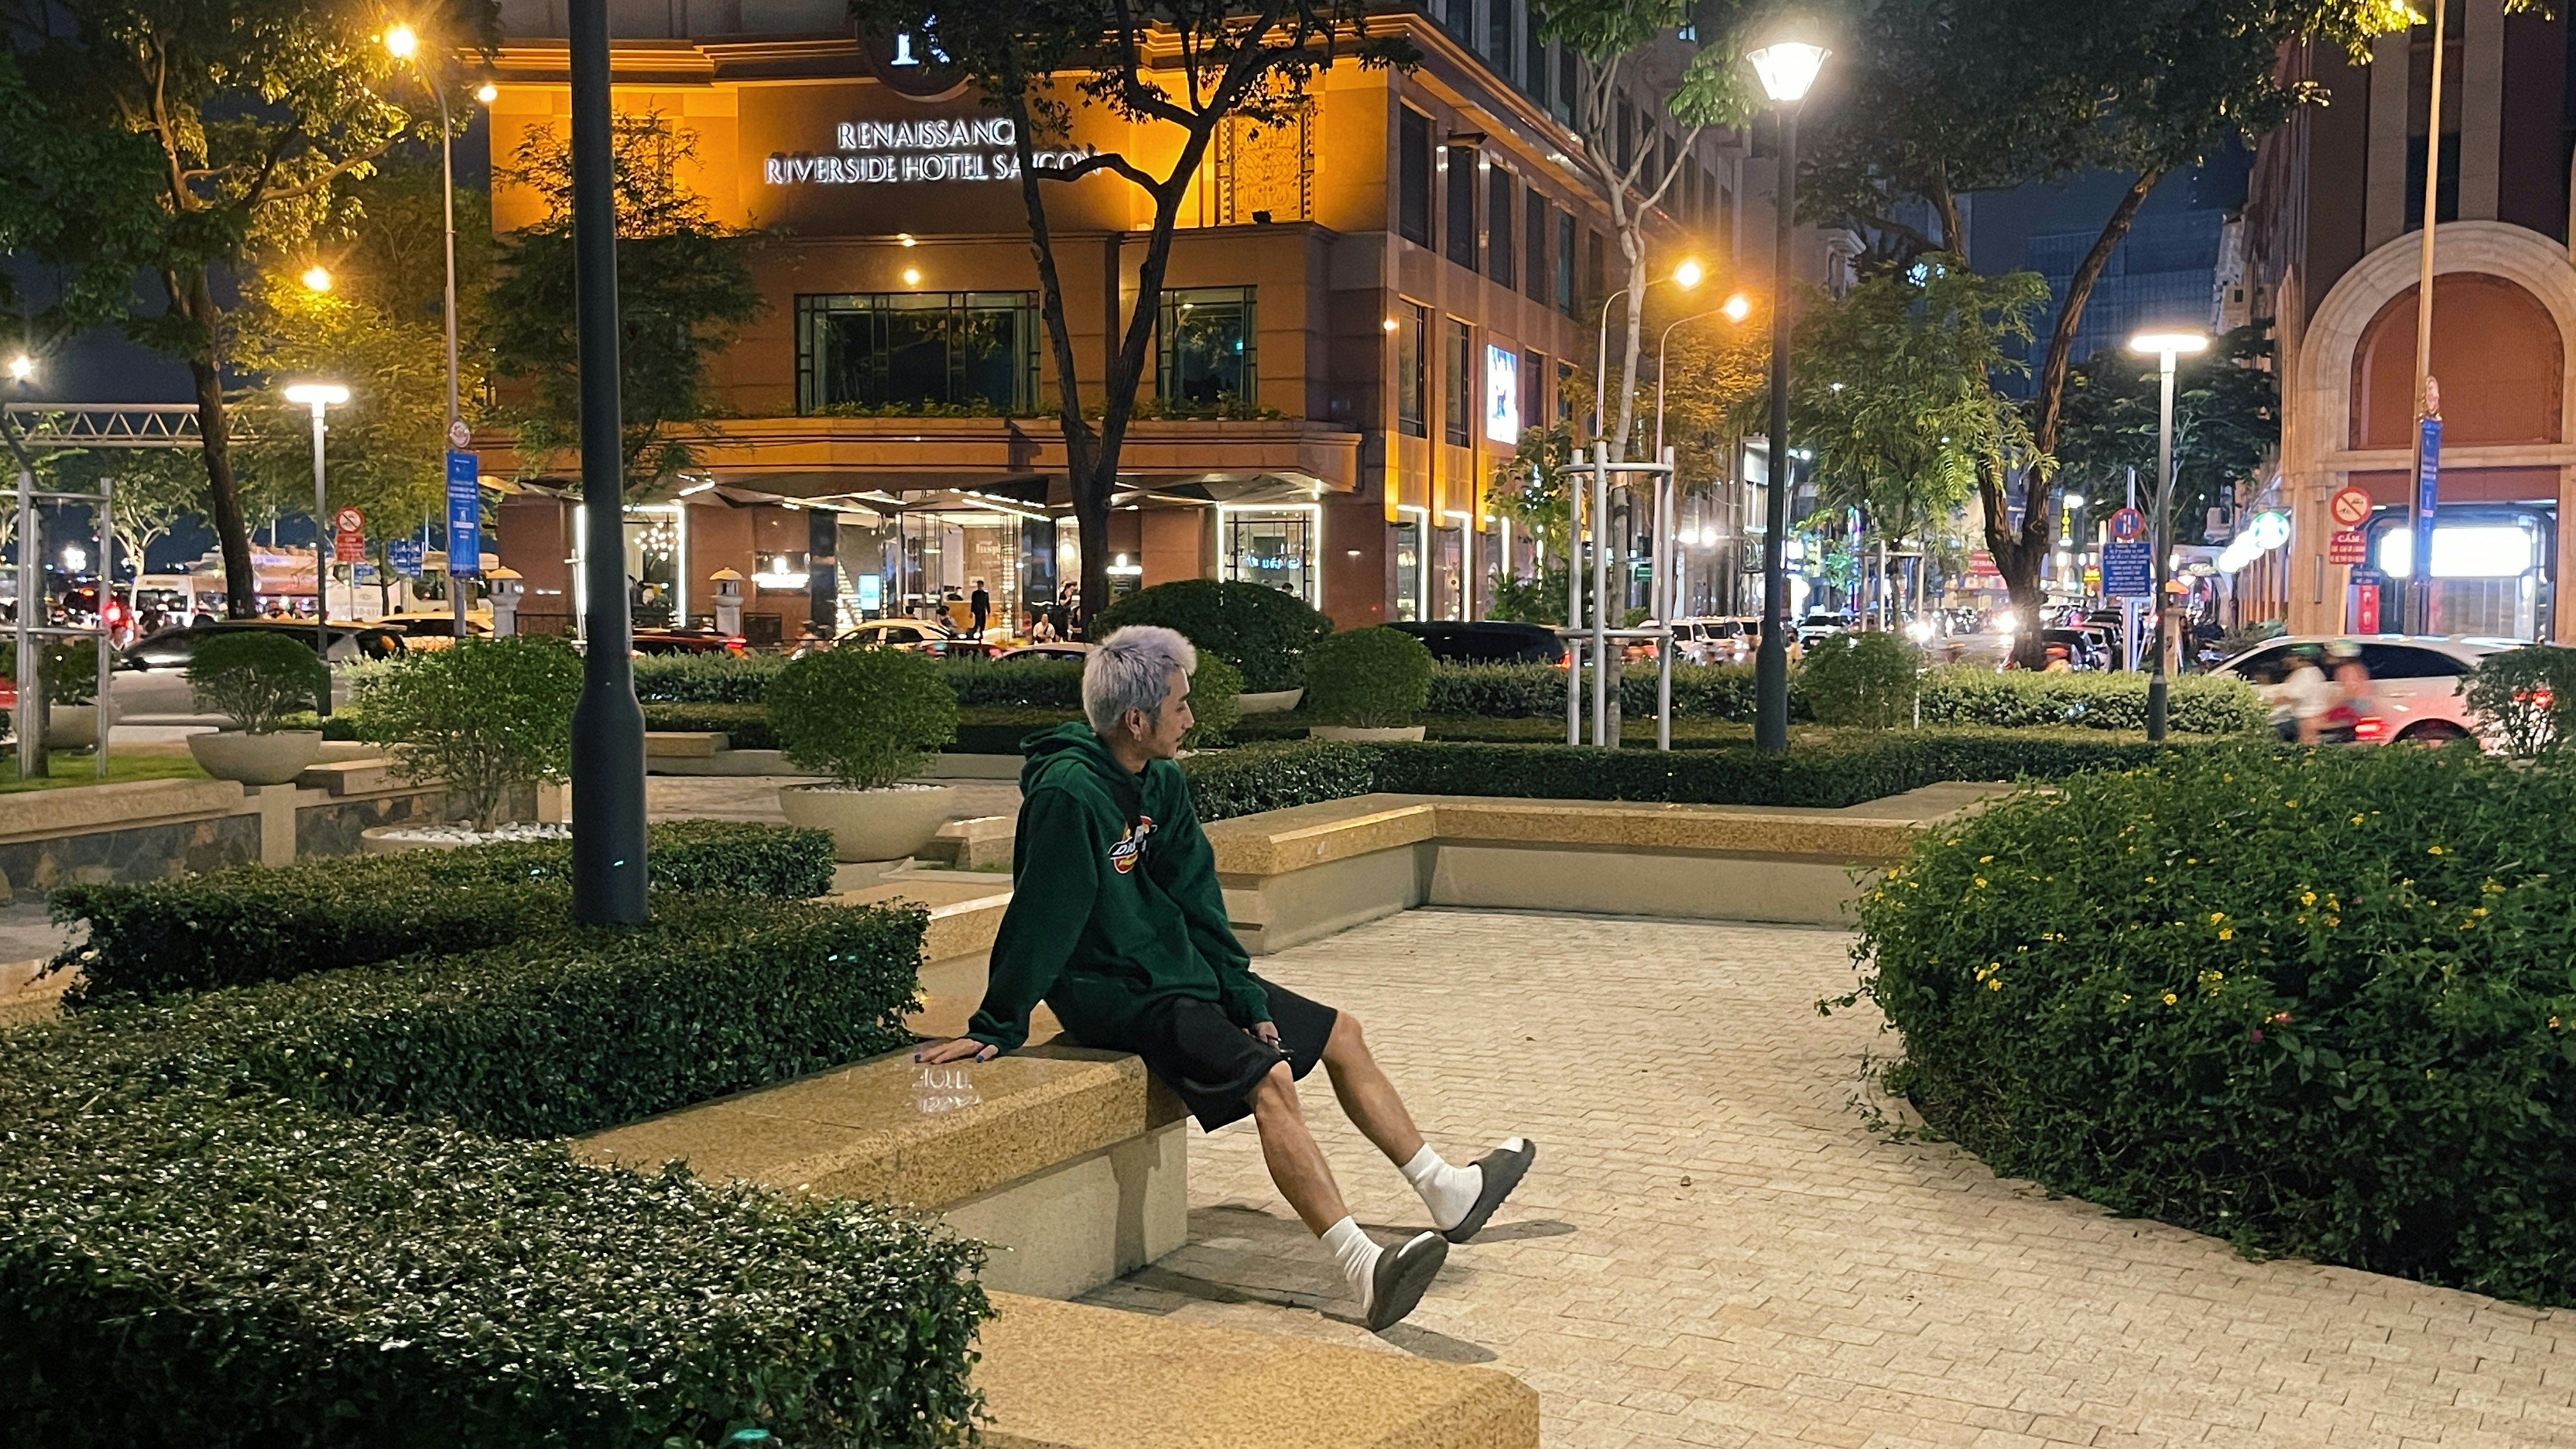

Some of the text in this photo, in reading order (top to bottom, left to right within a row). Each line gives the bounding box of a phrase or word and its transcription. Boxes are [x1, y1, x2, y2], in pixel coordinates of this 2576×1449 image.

[838, 118, 1016, 149] RENAISSANC
[765, 157, 897, 184] RIVERSIDE
[901, 153, 989, 181] HOTEL
